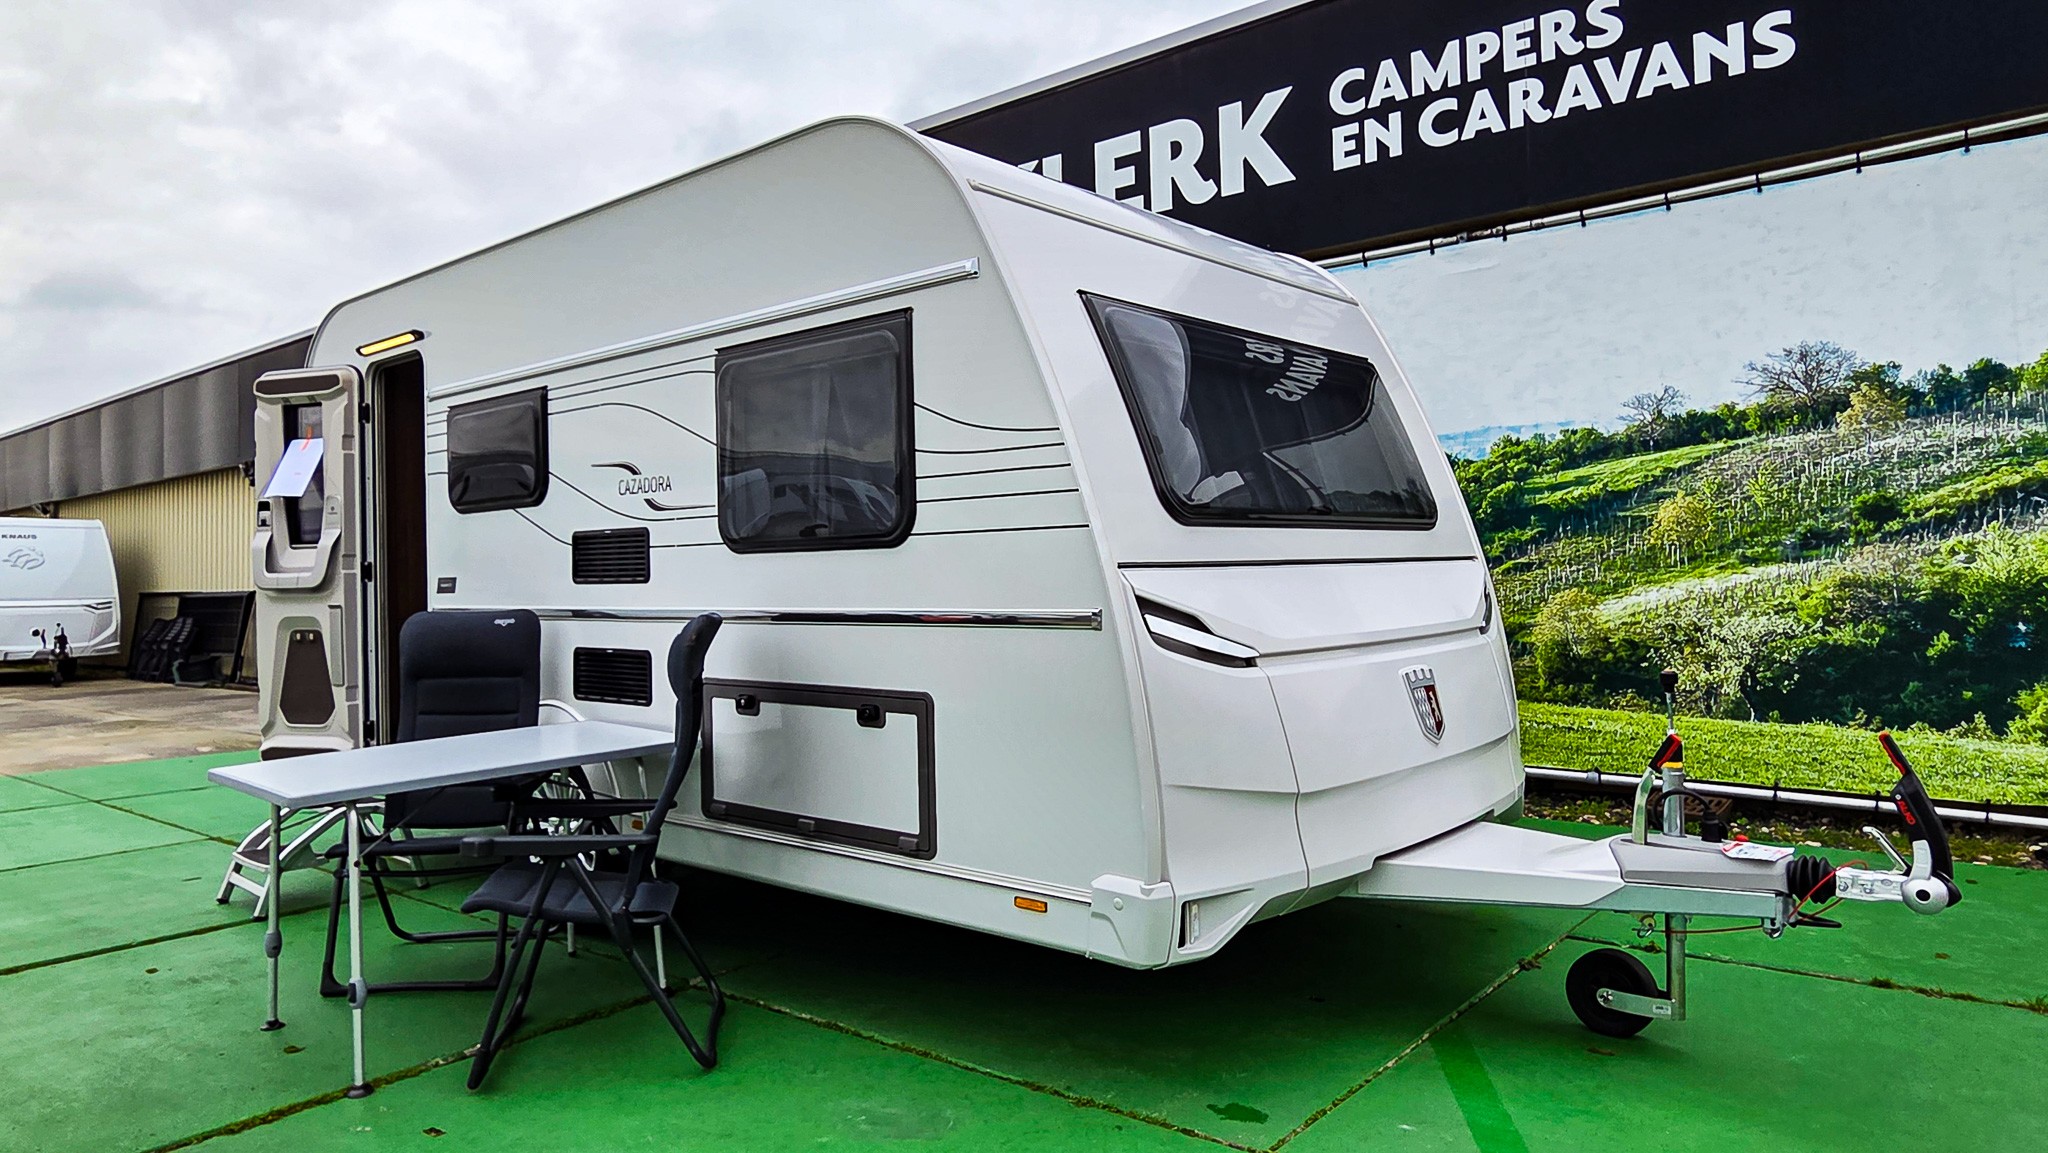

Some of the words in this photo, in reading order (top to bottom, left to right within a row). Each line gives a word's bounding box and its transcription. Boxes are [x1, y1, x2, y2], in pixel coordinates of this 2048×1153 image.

[1329, 0, 1624, 116] CAMPERS
[1332, 111, 1403, 171] EN
[1418, 10, 1797, 148] CARAVANS
[1018, 86, 1297, 213] ERK
[618, 475, 673, 496] CAZADORA
